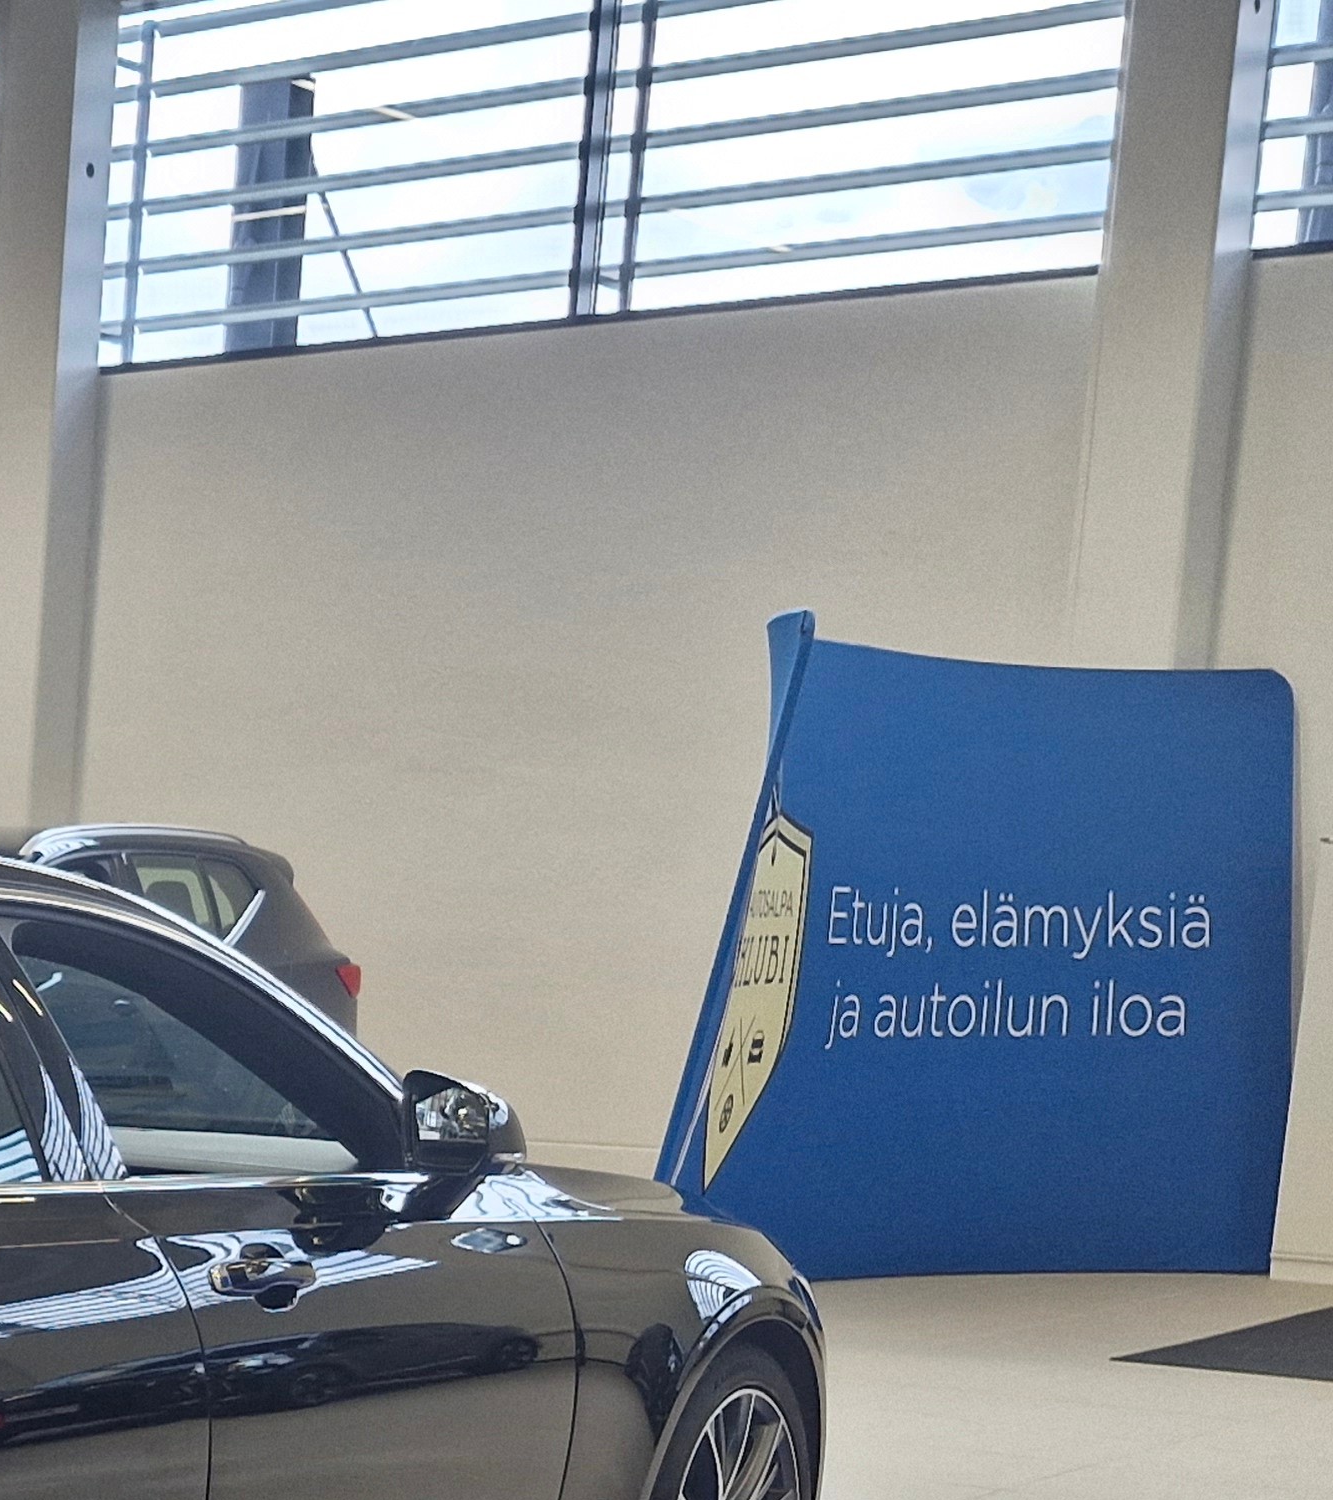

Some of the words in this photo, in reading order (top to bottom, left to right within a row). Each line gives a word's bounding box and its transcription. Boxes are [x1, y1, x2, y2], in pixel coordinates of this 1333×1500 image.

[749, 890, 794, 918] TOSALPA
[828, 885, 933, 958] Etuja,
[951, 888, 1211, 960] elämyksiä
[734, 935, 790, 988] KLUBI
[824, 979, 861, 1050] ja
[873, 978, 1069, 1038] autoilun
[1090, 978, 1187, 1037] iloa
